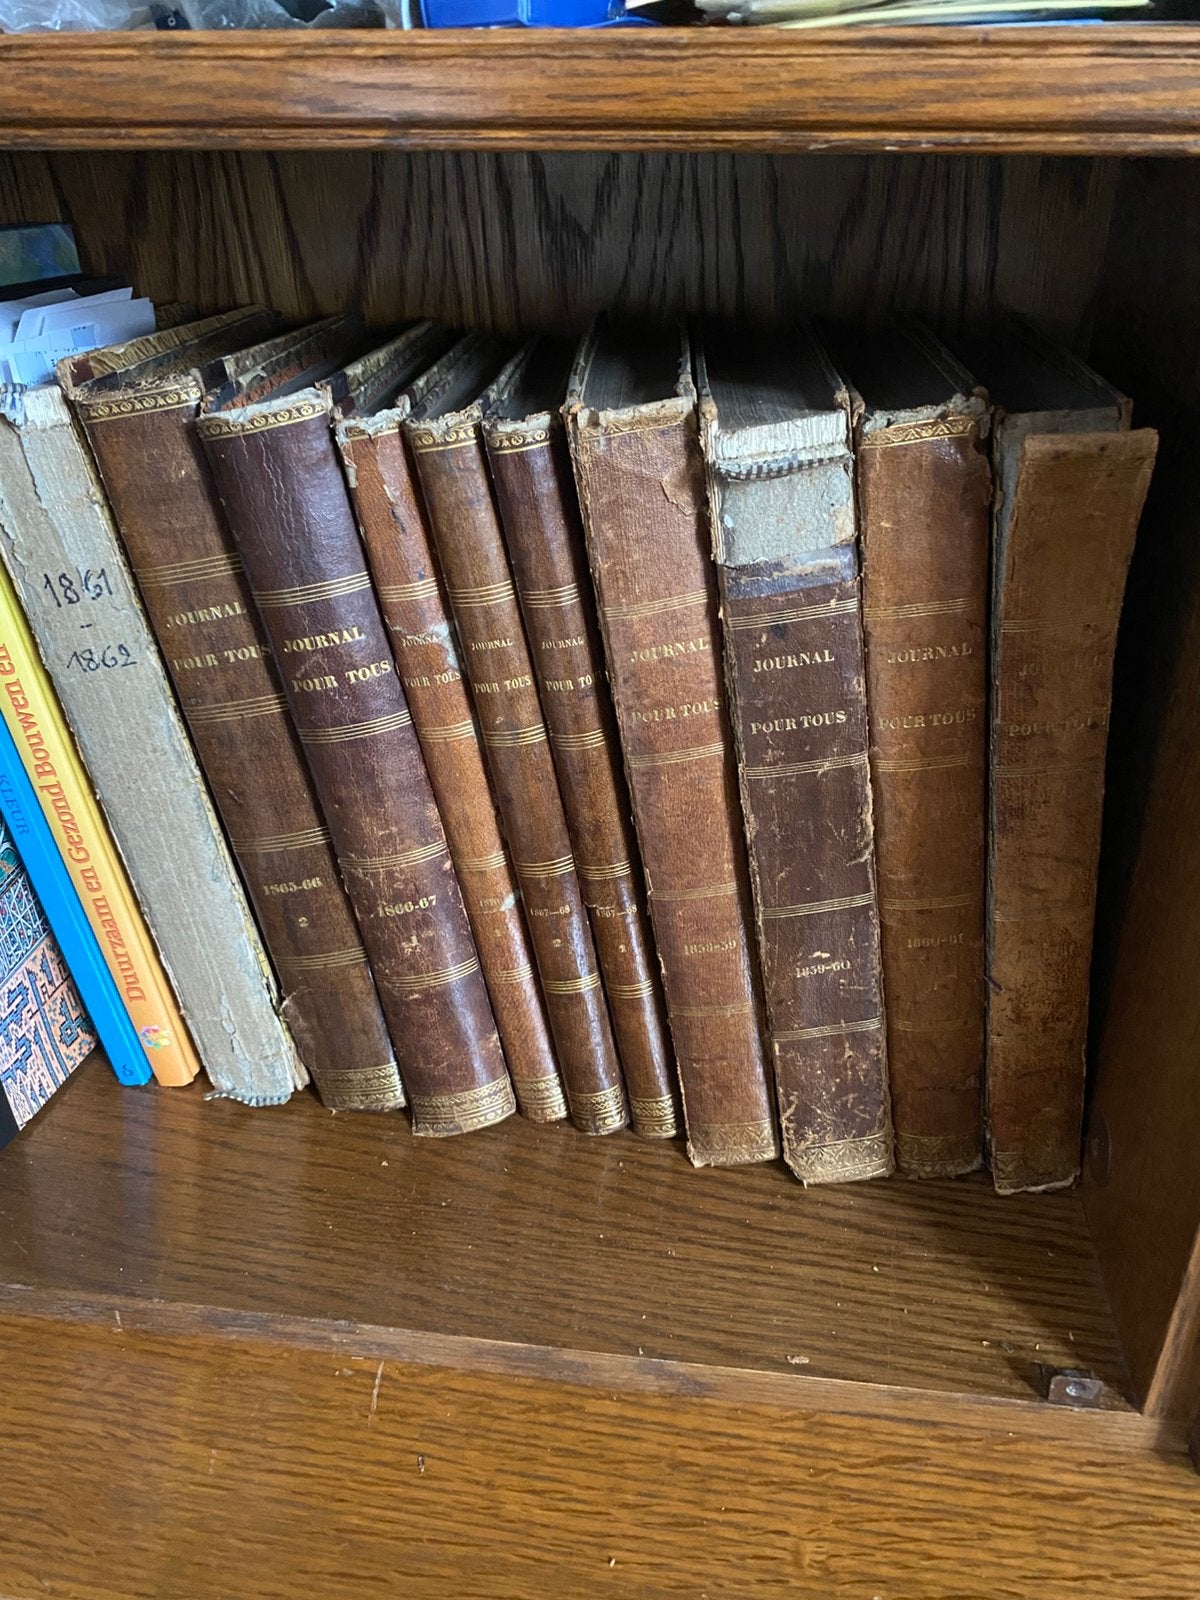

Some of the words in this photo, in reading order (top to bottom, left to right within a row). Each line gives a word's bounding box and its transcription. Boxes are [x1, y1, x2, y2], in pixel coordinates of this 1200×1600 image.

[44, 568, 113, 607] 1861
[166, 601, 247, 628] JOURNAL
[284, 626, 367, 653] JOURNAL
[471, 638, 513, 651] JOURNAL
[542, 636, 584, 650] JOURNAL
[631, 637, 709, 662] JOURNAL
[66, 643, 137, 673] 1862
[173, 652, 219, 671] POUR
[224, 643, 272, 664] TOUS
[753, 649, 835, 673] JOURNAL
[887, 642, 972, 664] JOURNAL
[291, 675, 339, 693] POUR
[345, 659, 392, 685] TOUS
[404, 675, 431, 688] POUR
[474, 682, 500, 694] POUR
[504, 675, 531, 691] TOUS
[545, 680, 574, 692] POUR
[631, 707, 676, 722] POUR
[680, 700, 720, 717] TOUS
[750, 717, 797, 735] POUR
[800, 710, 847, 728] TOUS
[878, 715, 926, 730] POUR
[929, 708, 976, 726] TOUS
[5, 678, 57, 780] Bouwen
[38, 779, 91, 864] Gezond
[79, 865, 103, 893] en
[263, 877, 322, 896] 1865-66
[378, 895, 437, 917] 1866-67
[298, 916, 309, 928] 2
[92, 895, 147, 1002] Duurzaam
